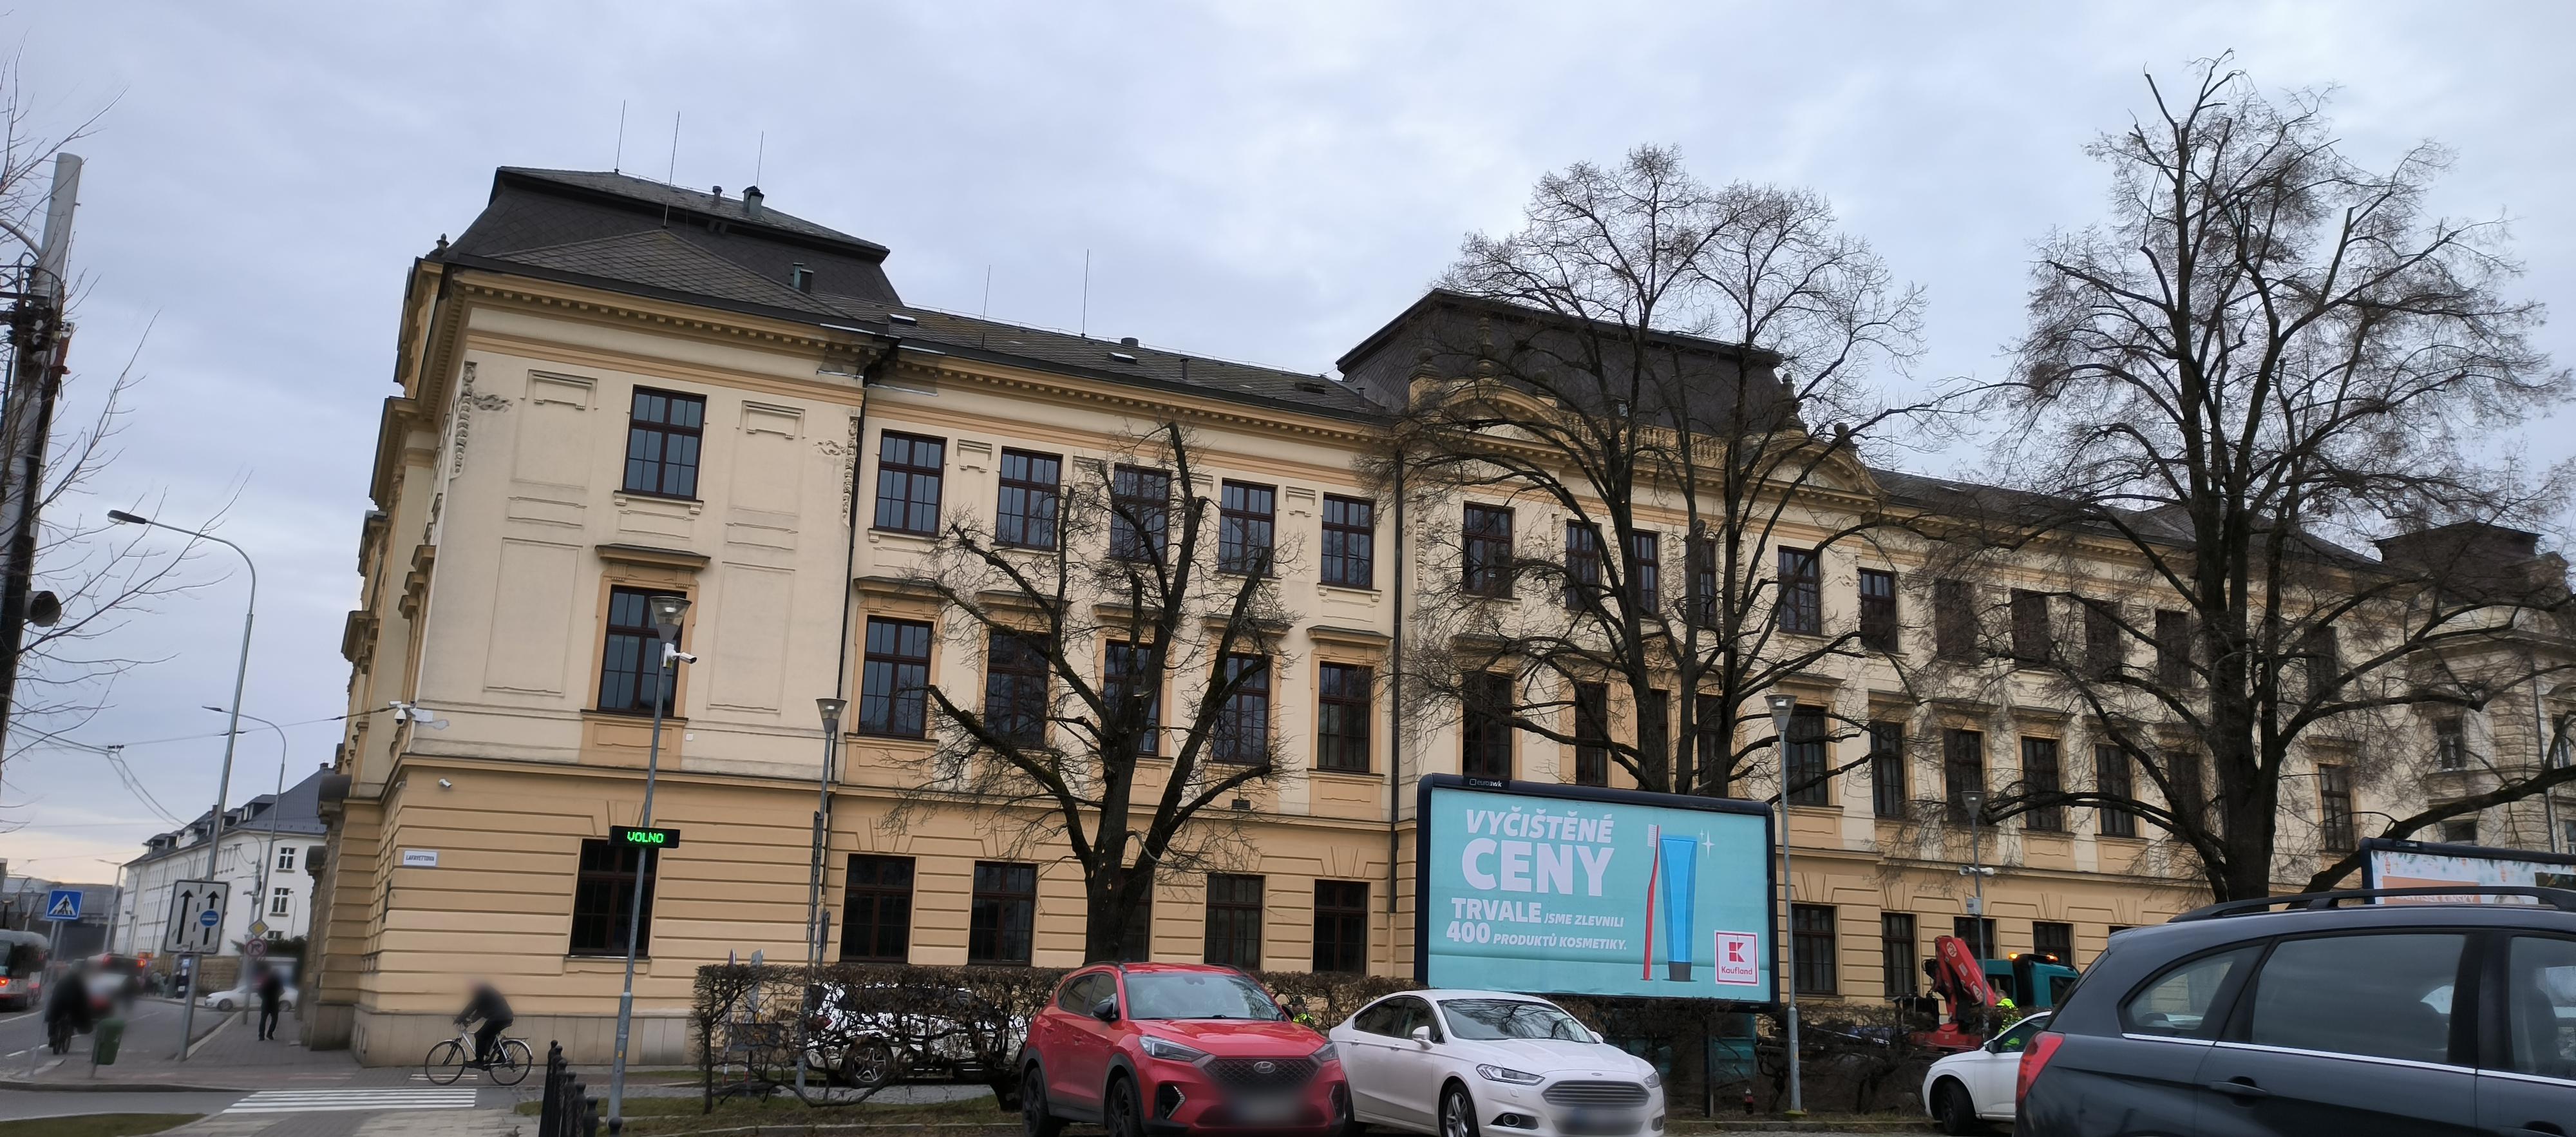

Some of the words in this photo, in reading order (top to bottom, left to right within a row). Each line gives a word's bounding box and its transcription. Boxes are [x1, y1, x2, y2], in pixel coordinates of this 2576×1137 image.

[627, 831, 664, 843] VOLNO
[1466, 806, 1615, 843] VYČIŠTĚNÉ
[1462, 837, 1615, 897] CENY
[1451, 897, 1542, 923] TRVALE
[1544, 913, 1572, 925] JSME
[1575, 915, 1624, 928] ZLEVNILI
[1446, 921, 1491, 944] 400
[1493, 933, 1557, 947] PRODUKTŮ
[1559, 937, 1627, 950] KOSMETIKY.
[1721, 966, 1753, 975] Kaufland
